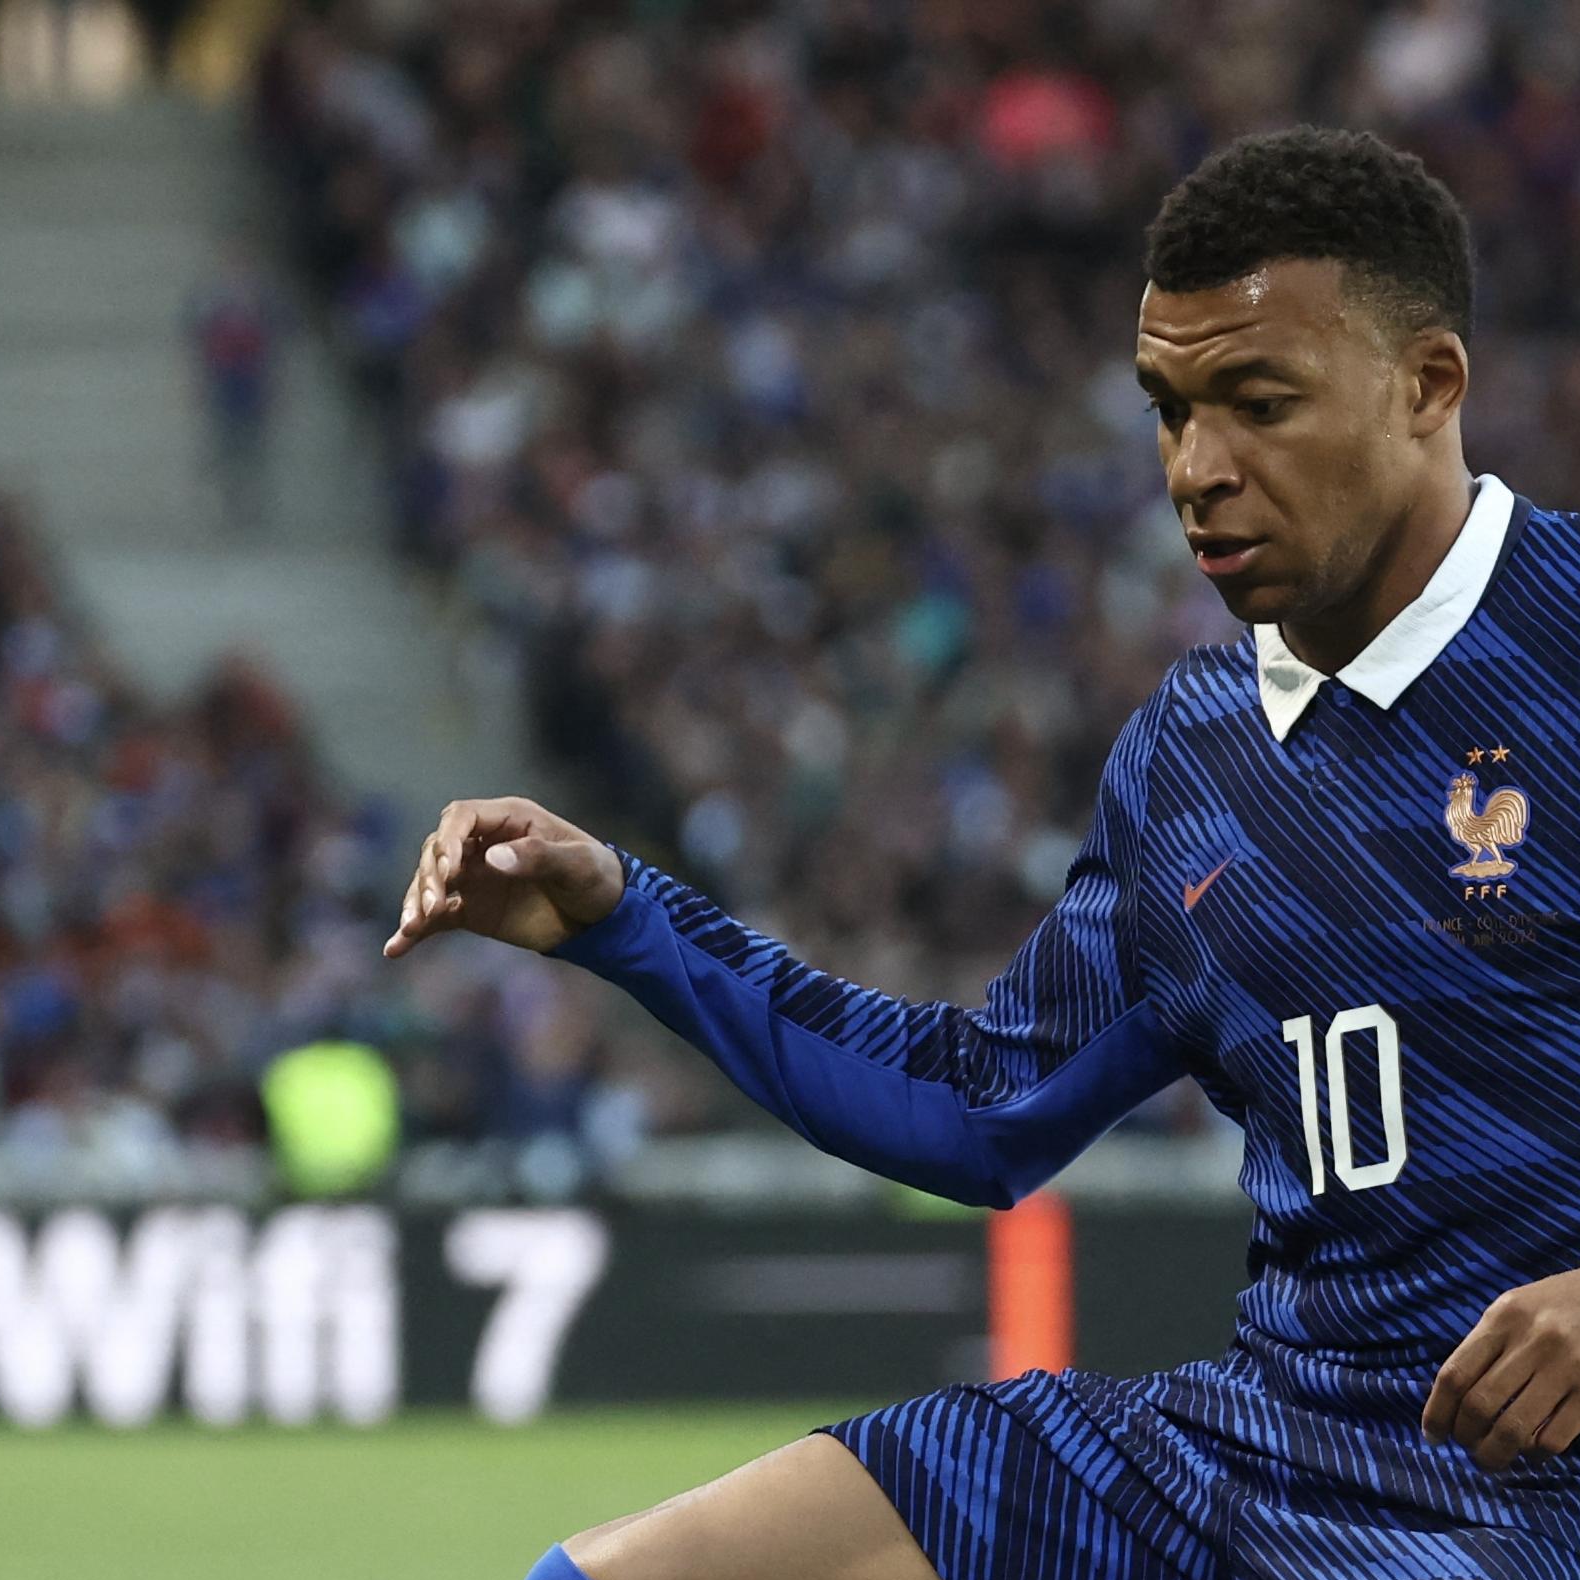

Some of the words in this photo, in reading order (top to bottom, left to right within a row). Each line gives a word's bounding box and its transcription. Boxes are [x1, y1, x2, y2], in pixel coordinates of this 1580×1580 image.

[1465, 884, 1507, 900] FFF
[1282, 1004, 1408, 1196] 10
[444, 1208, 608, 1427] 7
